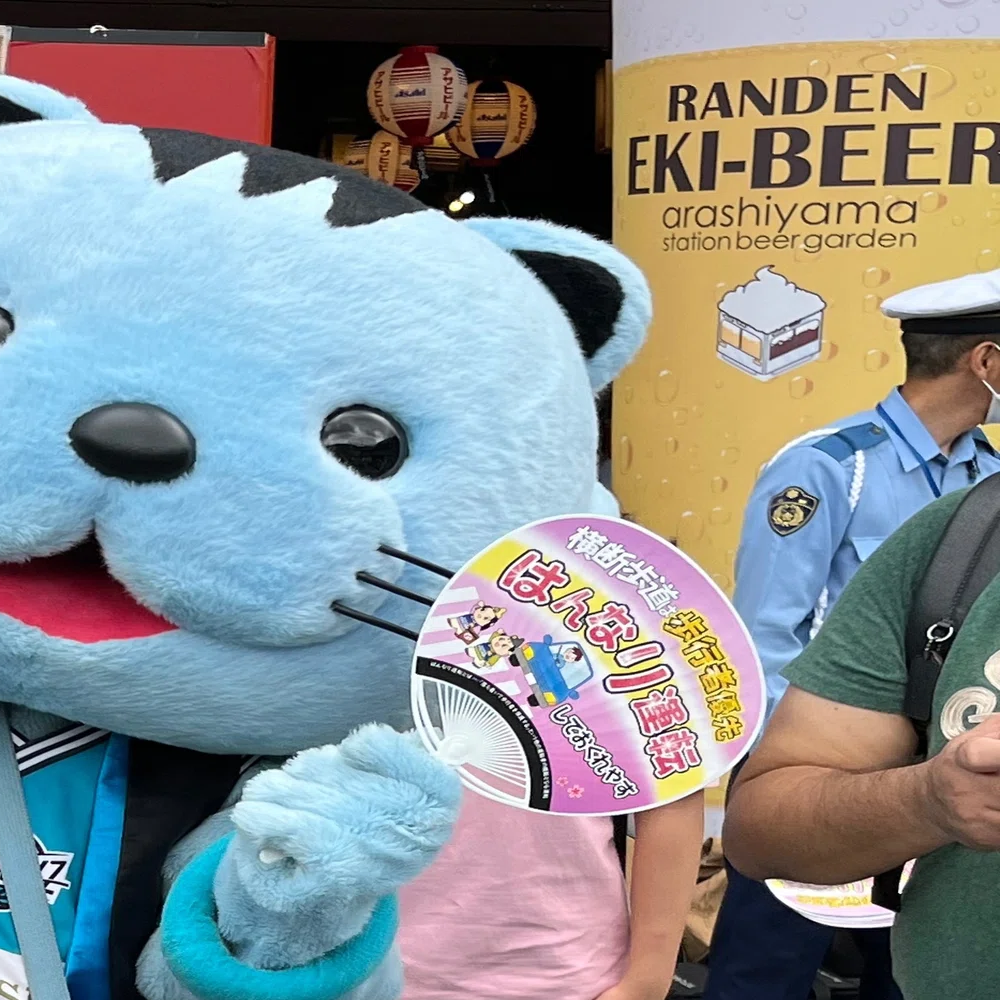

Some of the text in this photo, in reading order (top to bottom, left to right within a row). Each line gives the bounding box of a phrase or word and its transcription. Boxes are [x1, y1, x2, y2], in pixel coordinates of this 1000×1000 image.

[667, 72, 928, 123] RANDEN
[627, 122, 1000, 196] EKI-BEER
[662, 195, 918, 233] arashiyama
[662, 228, 918, 254] station beer garden
[497, 549, 703, 780] はんなり運転
[662, 608, 747, 744] 歩行者優先
[549, 702, 641, 800] しておくれやす
